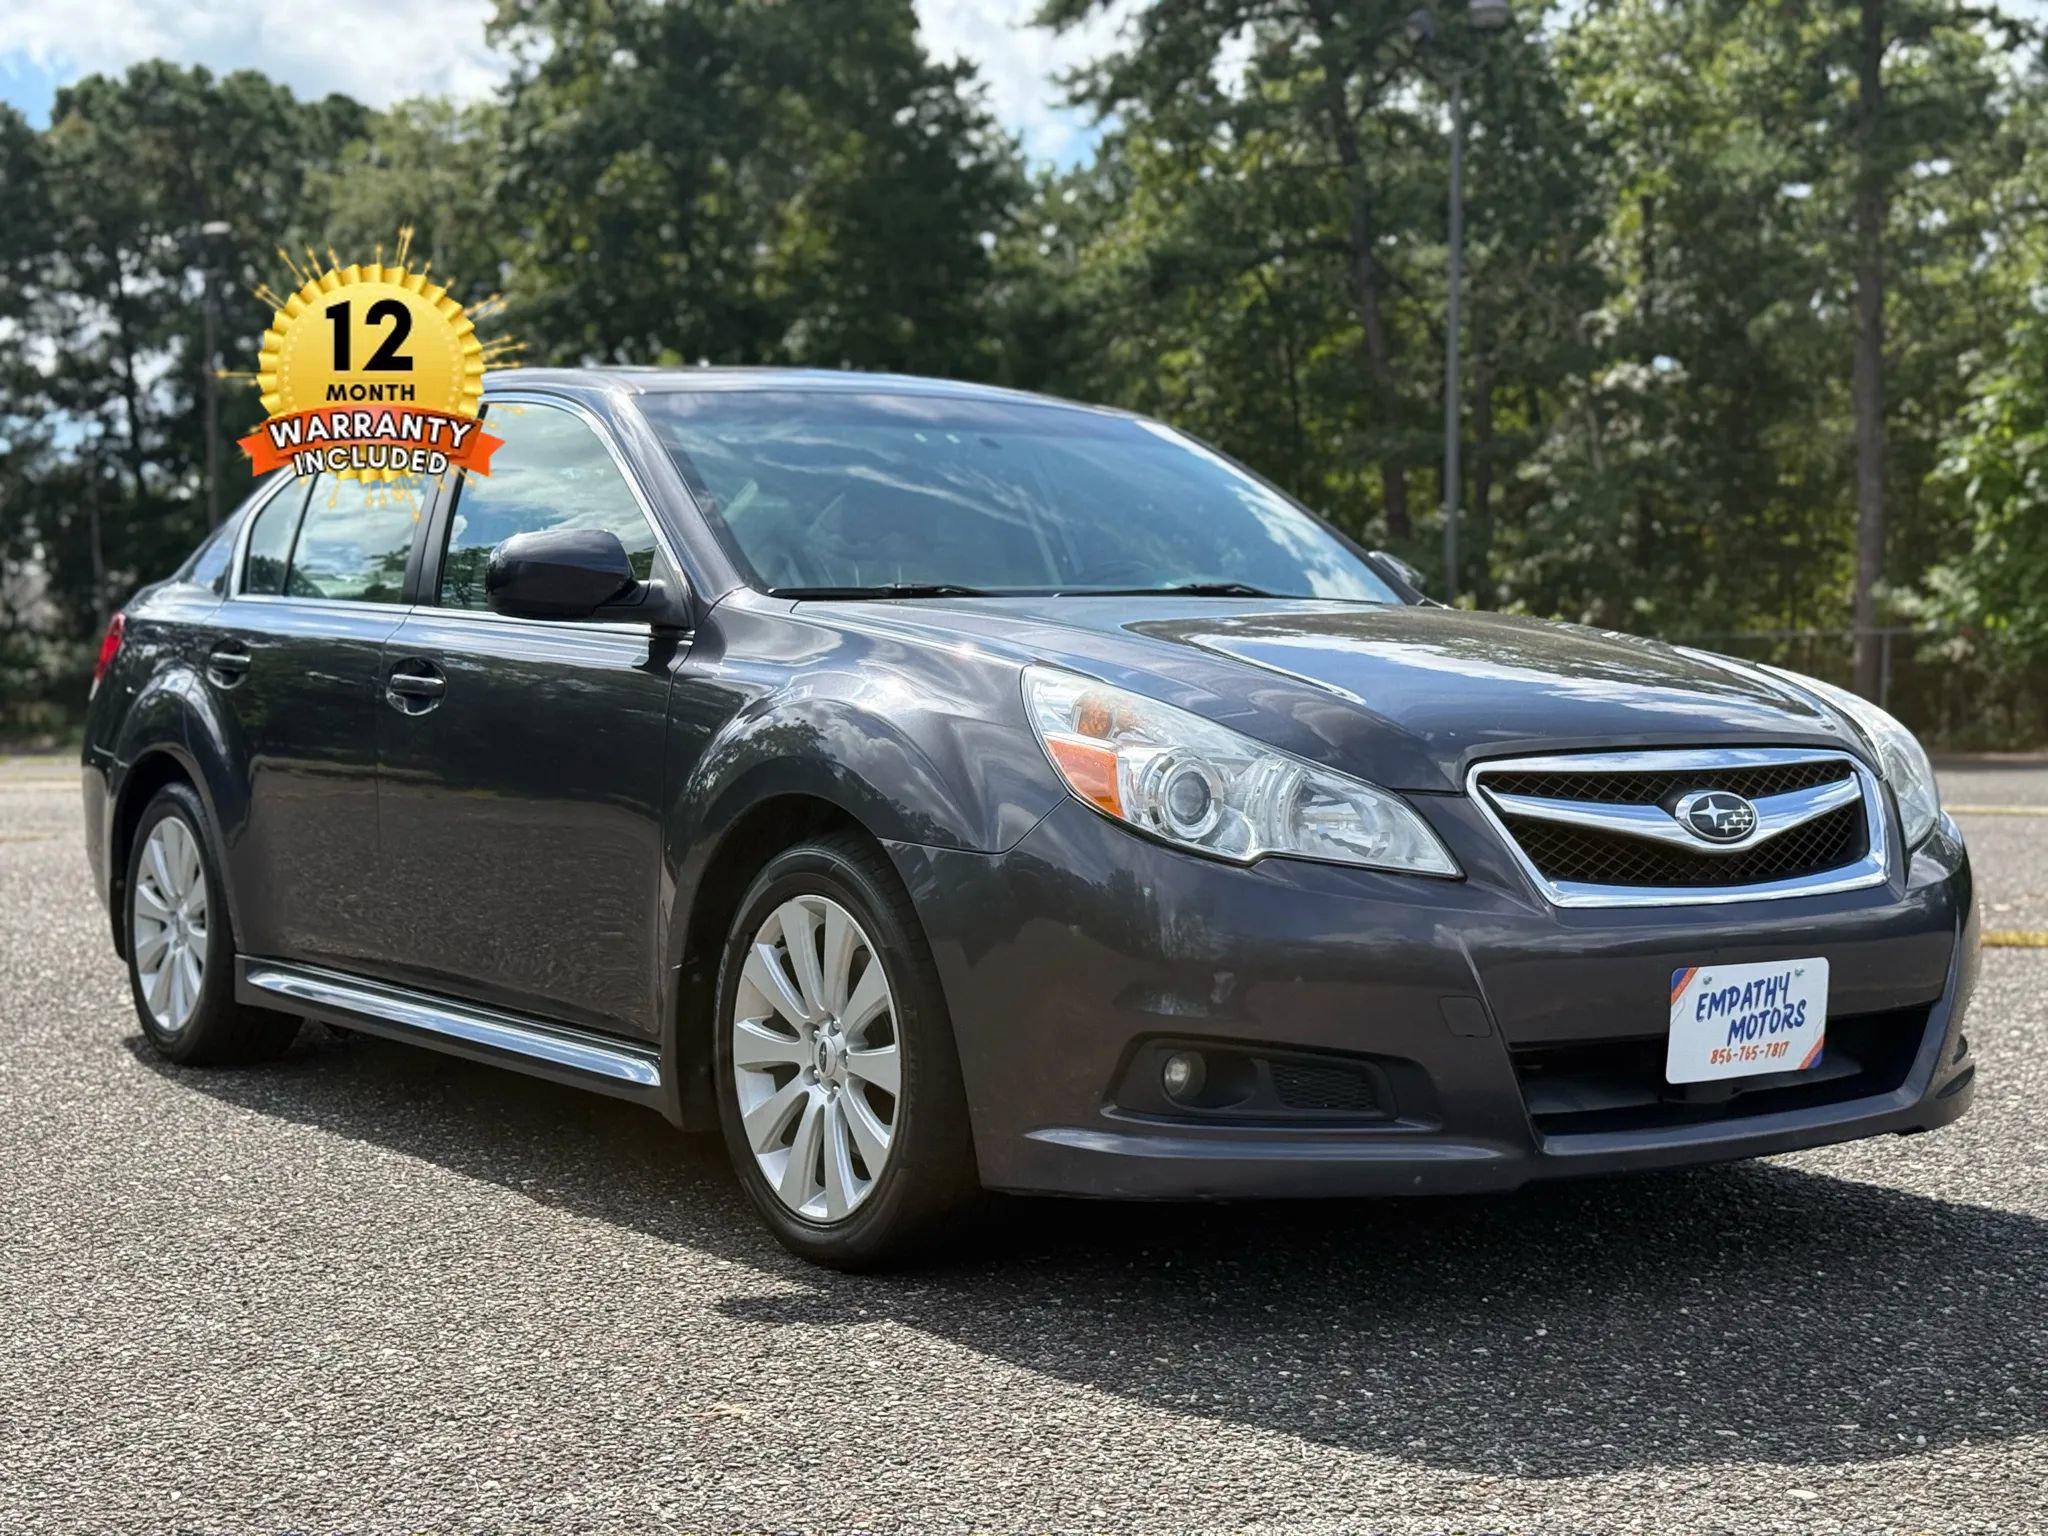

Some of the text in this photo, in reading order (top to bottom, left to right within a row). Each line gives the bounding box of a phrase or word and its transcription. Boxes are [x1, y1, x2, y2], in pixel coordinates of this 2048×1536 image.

[1696, 972, 1789, 1022] EMPATHY
[1727, 999, 1806, 1045] MOTORS
[1711, 1041, 1789, 1064] 856-765-7817
